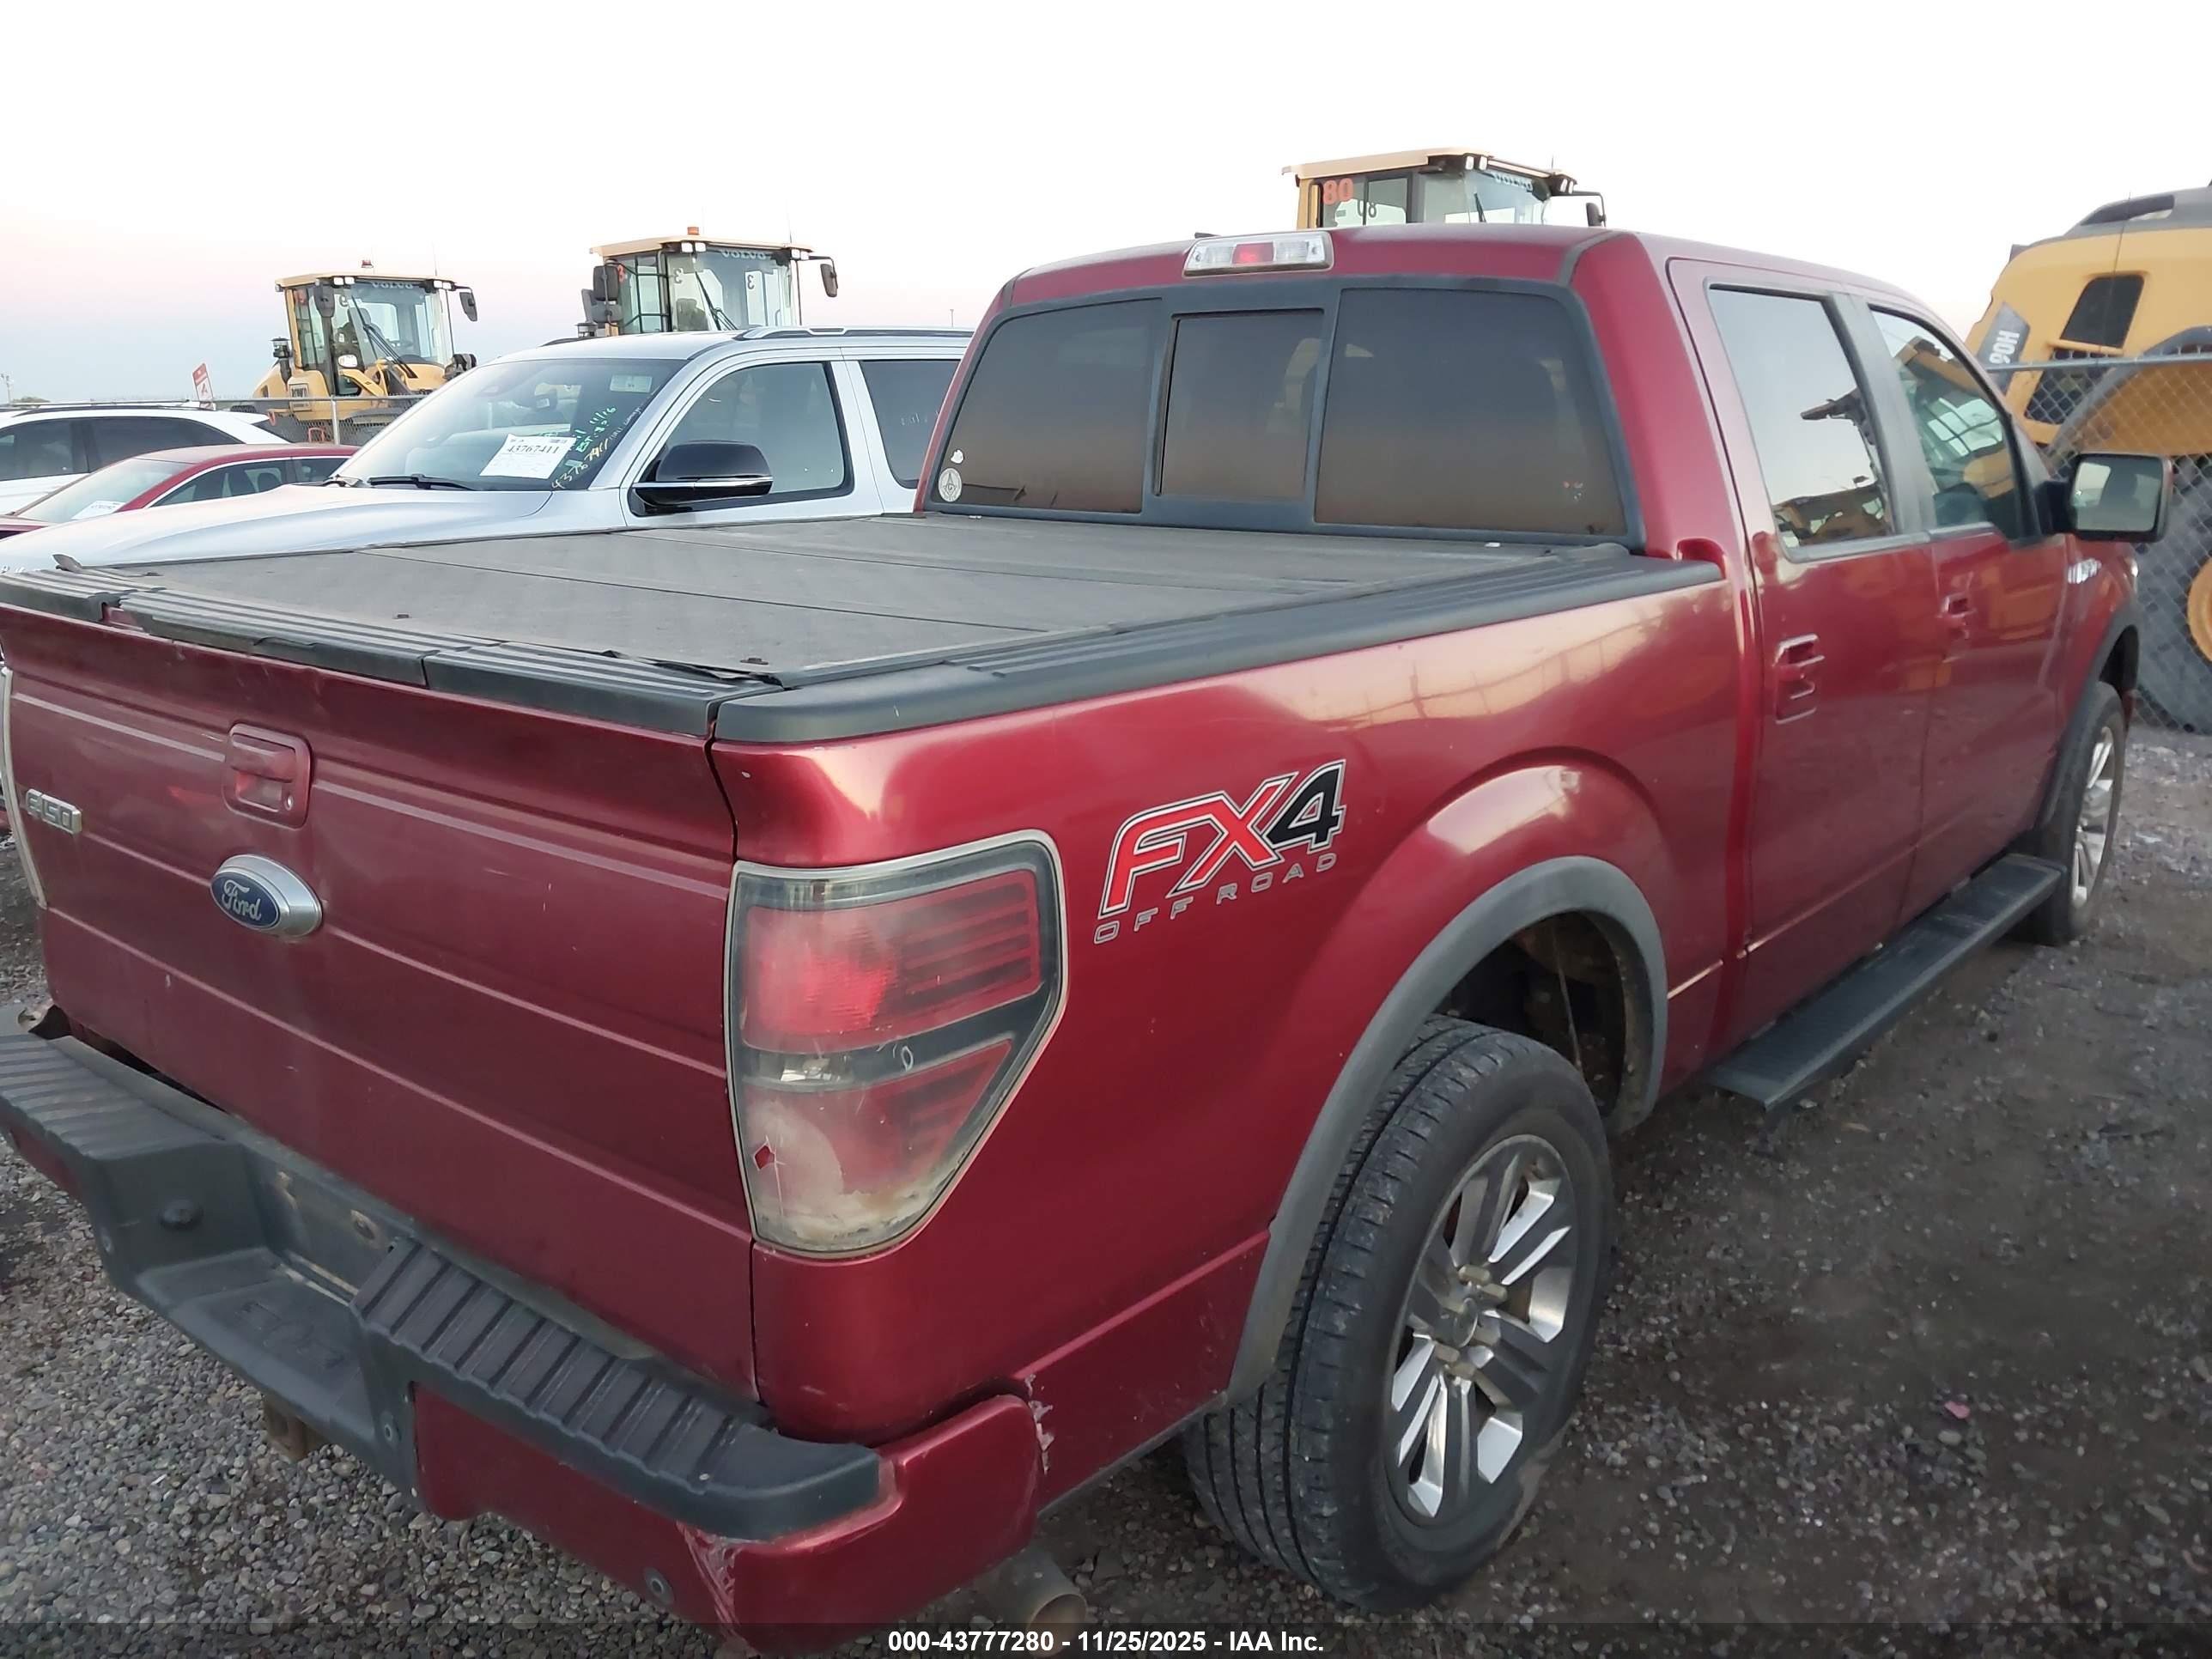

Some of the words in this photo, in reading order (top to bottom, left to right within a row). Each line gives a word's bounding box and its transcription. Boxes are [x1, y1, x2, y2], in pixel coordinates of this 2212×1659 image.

[1323, 178, 1354, 205] 80
[507, 444, 560, 455] 43767411
[1097, 758, 1346, 921] FX4
[222, 879, 262, 921] Ford
[1093, 896, 1194, 945] OFF
[1215, 852, 1337, 905] ROAD
